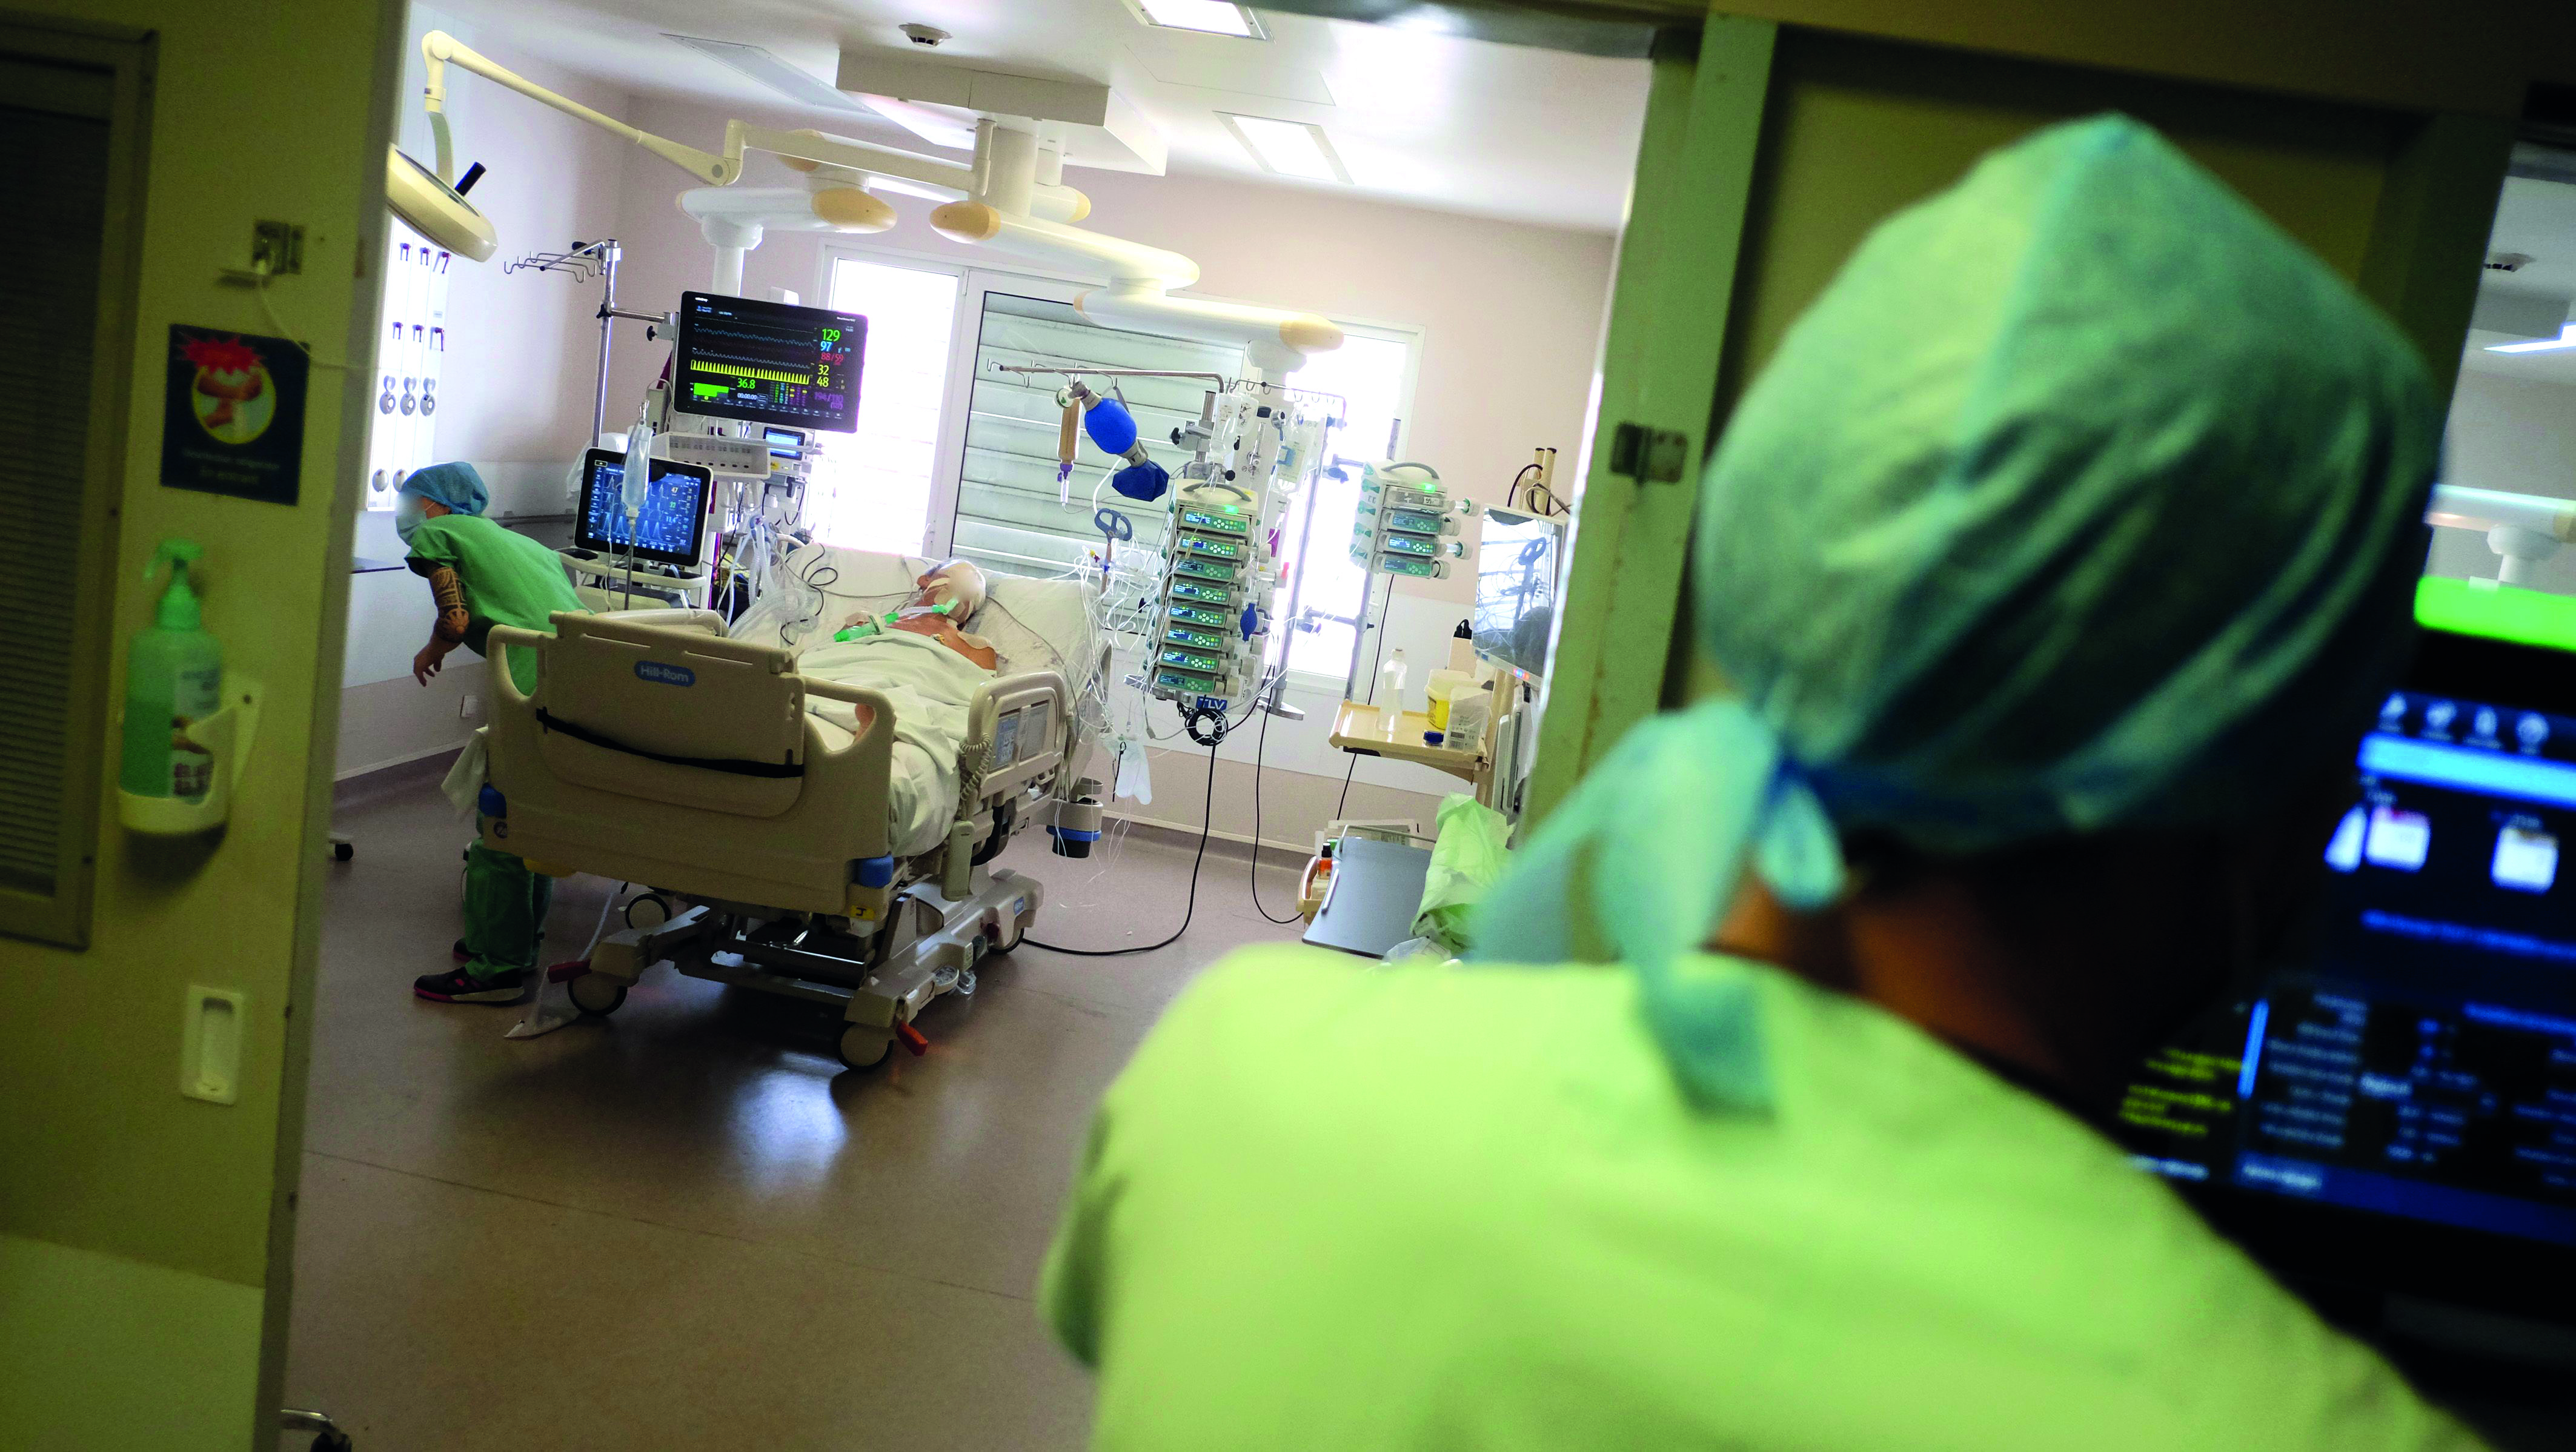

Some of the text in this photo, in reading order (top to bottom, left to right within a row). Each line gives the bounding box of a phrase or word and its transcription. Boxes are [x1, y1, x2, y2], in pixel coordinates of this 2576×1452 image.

[822, 328, 840, 342] 129
[820, 340, 832, 351] 97
[818, 364, 829, 375] 32
[737, 377, 755, 389] 36.8
[817, 376, 829, 387] 48
[640, 666, 689, 682] Hill-Rom
